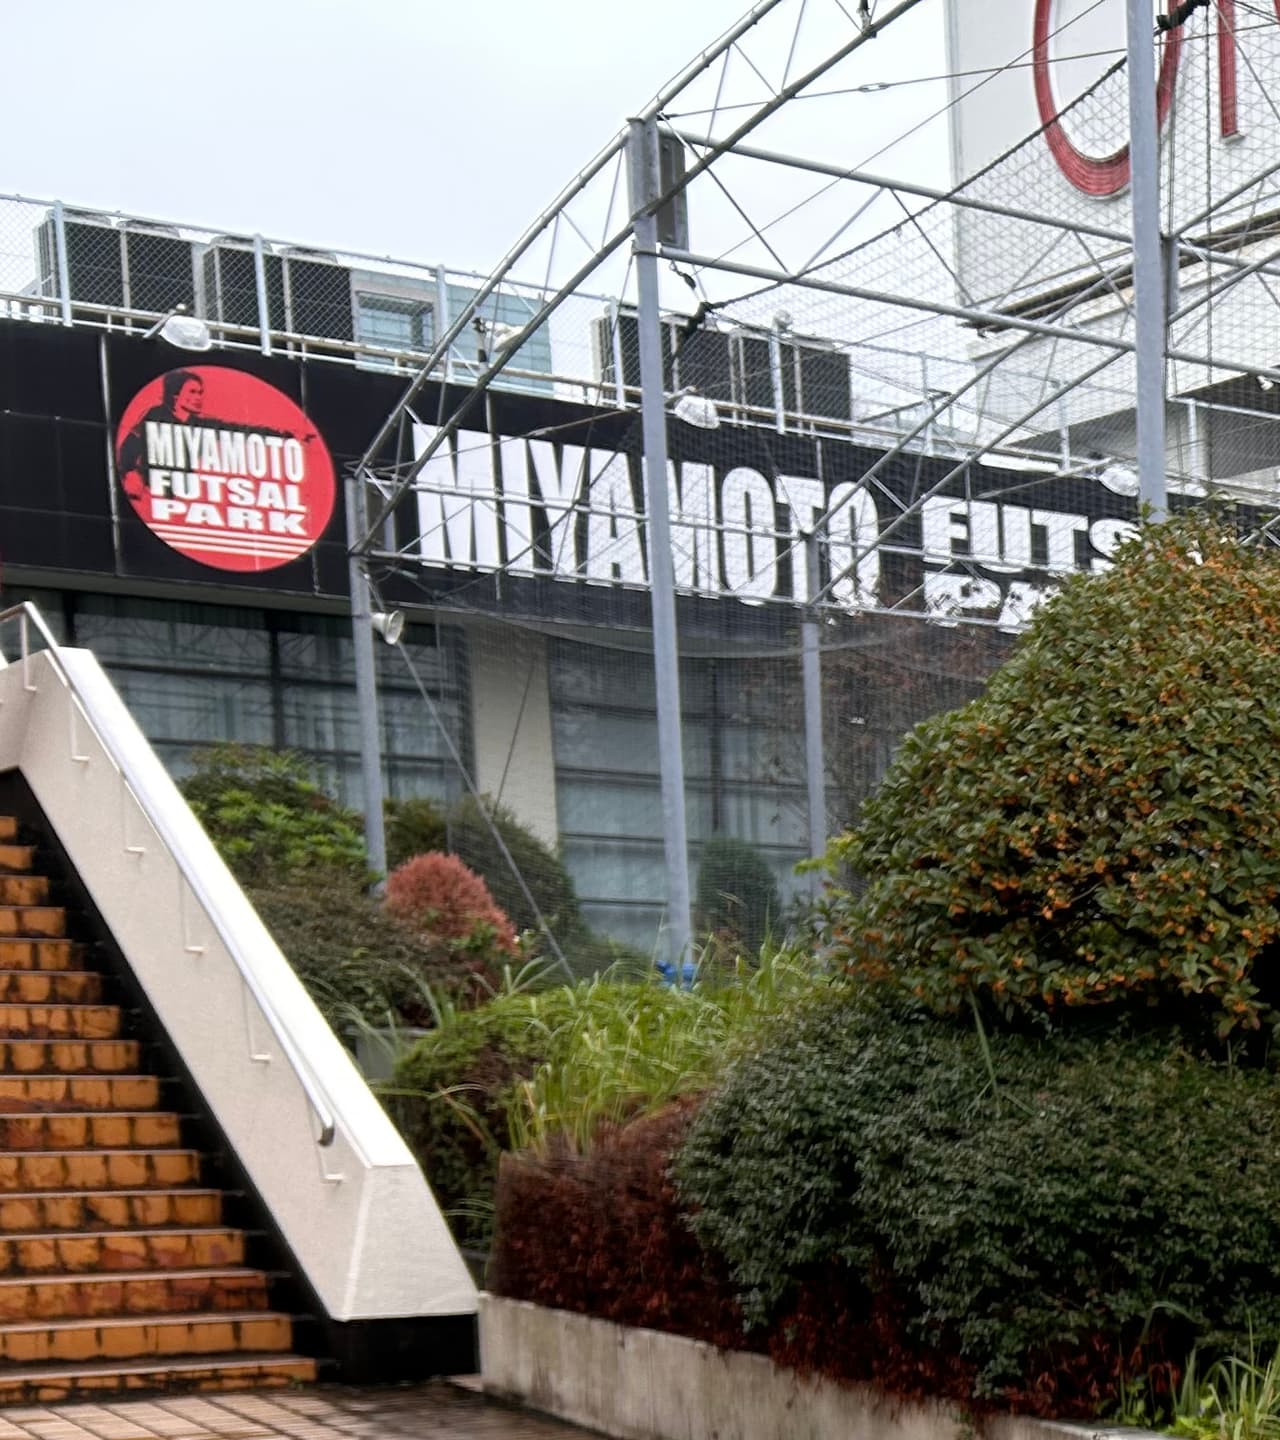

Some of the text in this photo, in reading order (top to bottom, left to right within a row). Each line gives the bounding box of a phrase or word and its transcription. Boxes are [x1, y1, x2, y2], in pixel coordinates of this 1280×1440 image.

[146, 421, 304, 481] MIYAMOTO
[150, 469, 307, 512] FUTSAL
[151, 499, 307, 535] PARK
[413, 423, 1141, 612] MIYAMOTO FUTS
